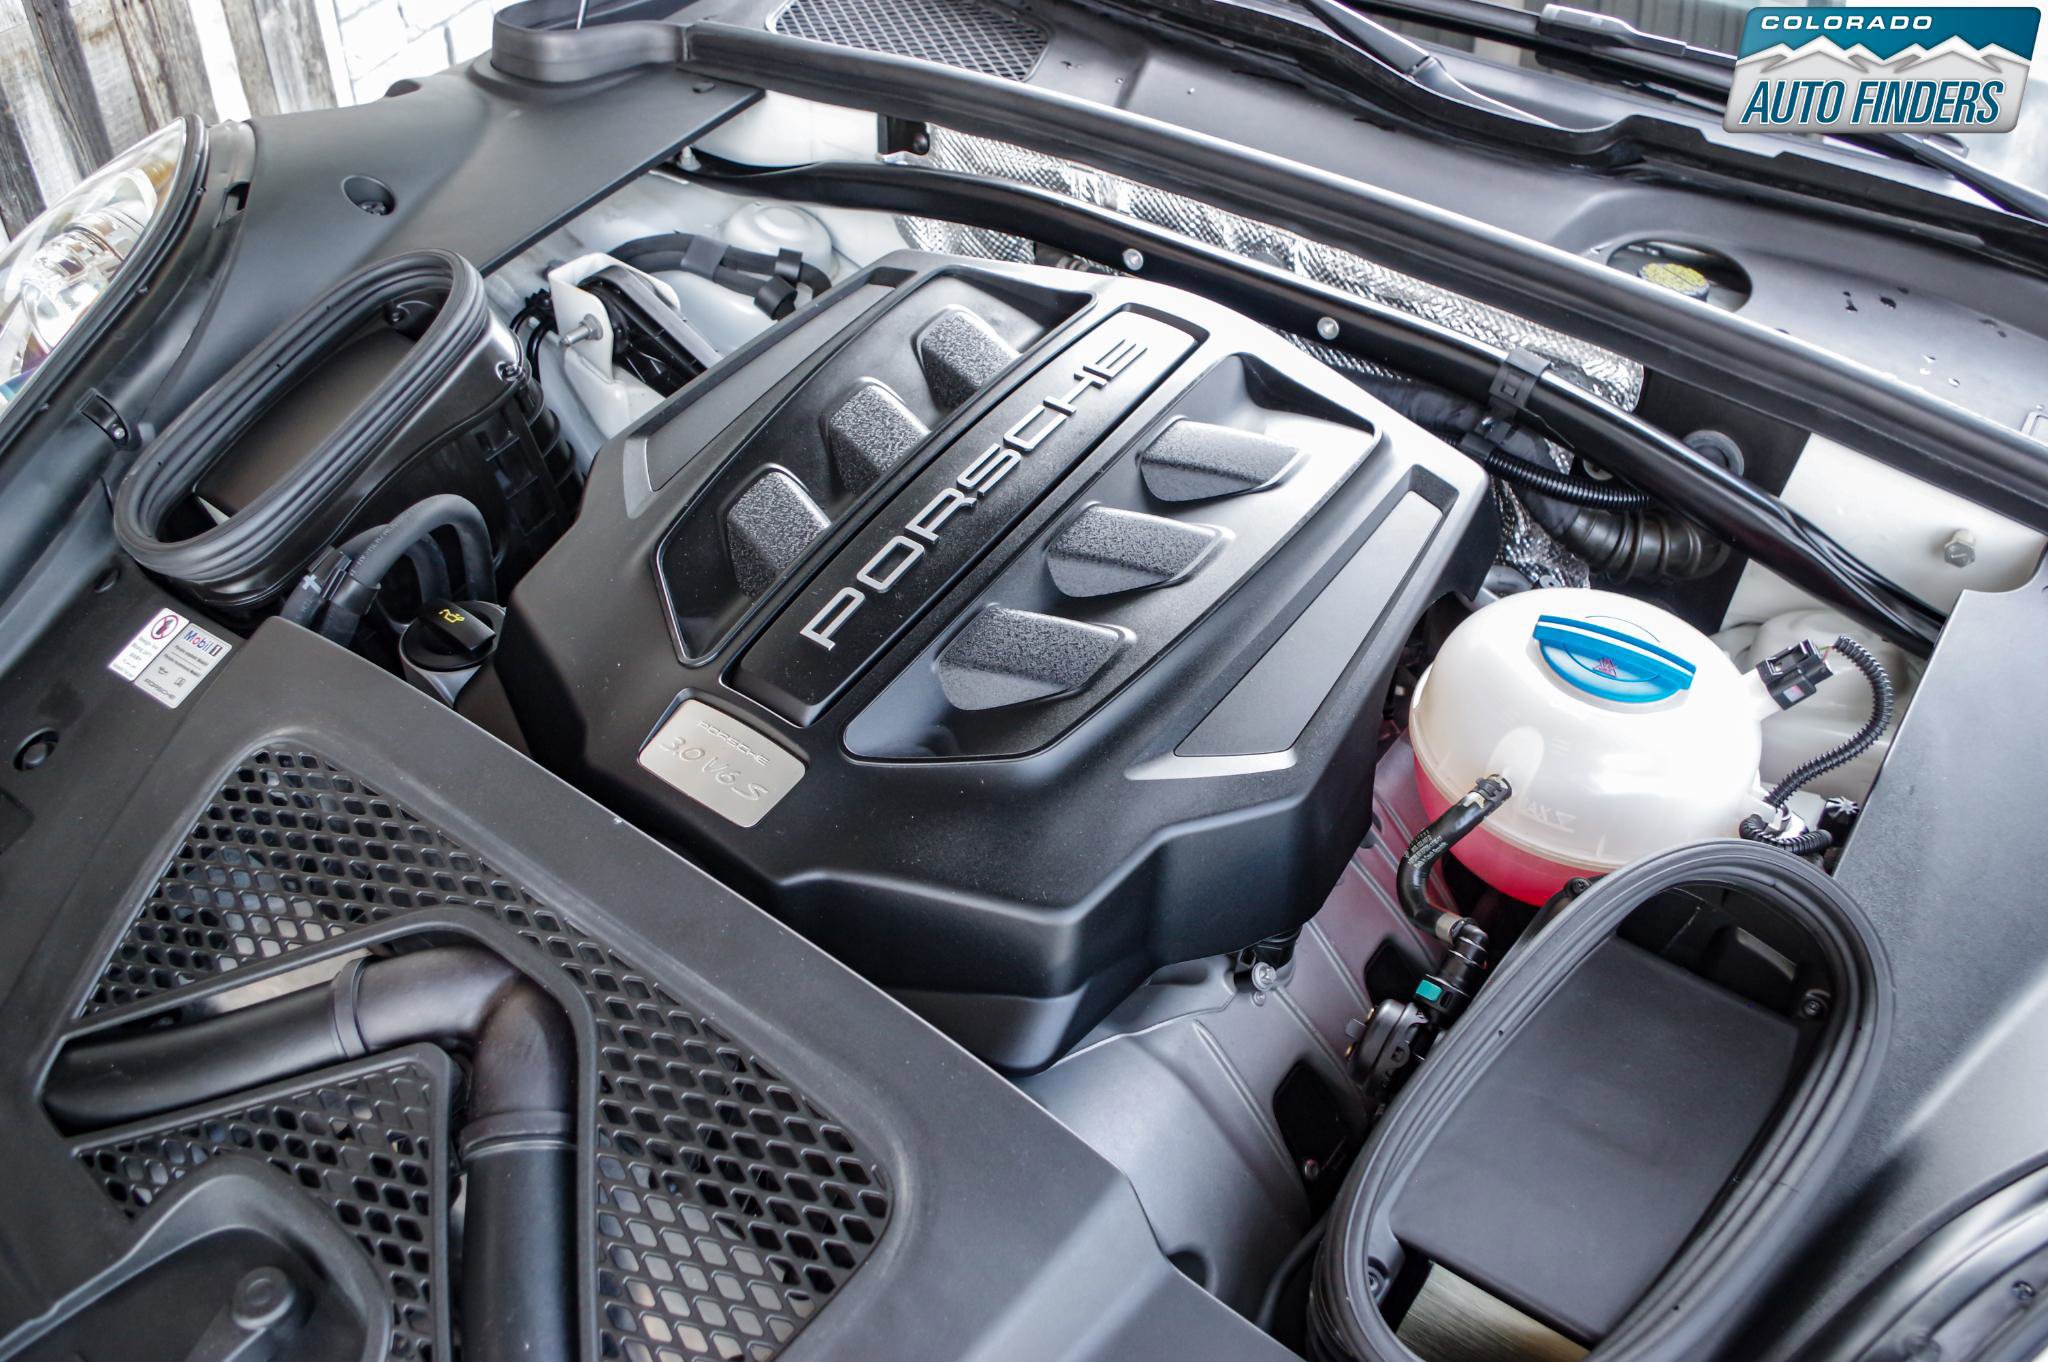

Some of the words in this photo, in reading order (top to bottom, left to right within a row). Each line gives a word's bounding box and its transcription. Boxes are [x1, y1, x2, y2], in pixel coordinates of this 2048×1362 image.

[800, 339, 1148, 651] PORSCHE
[184, 630, 214, 651] Mobil
[144, 678, 176, 699] PORSCHE
[697, 720, 771, 767] PORSCHE
[702, 756, 741, 785] V6
